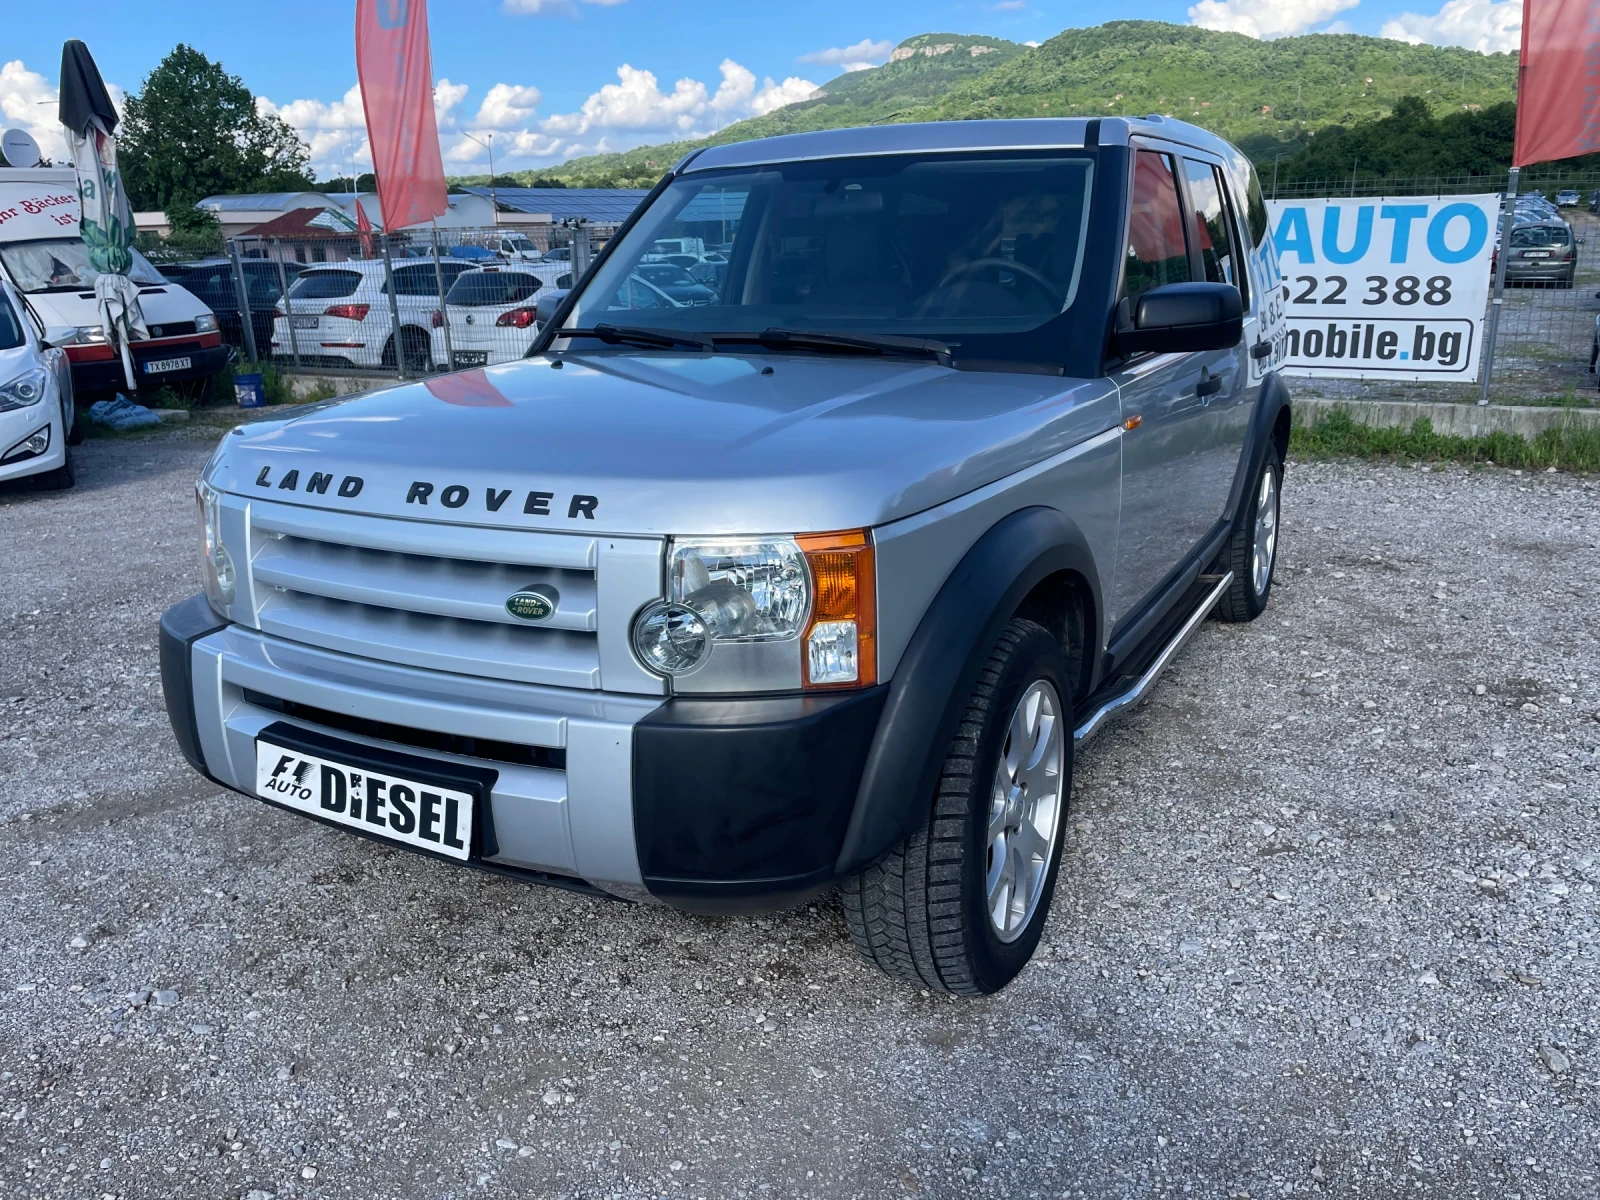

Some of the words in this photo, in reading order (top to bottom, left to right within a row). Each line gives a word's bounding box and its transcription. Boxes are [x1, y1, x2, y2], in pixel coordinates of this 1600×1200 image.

[19, 195, 77, 214] Bäcker
[50, 213, 78, 226] ist
[1274, 202, 1488, 265] AUTO
[1362, 275, 1452, 306] 388
[256, 466, 364, 498] LAND
[406, 481, 599, 519] ROVER
[516, 605, 544, 616] ROVER
[265, 777, 312, 800] AUTO
